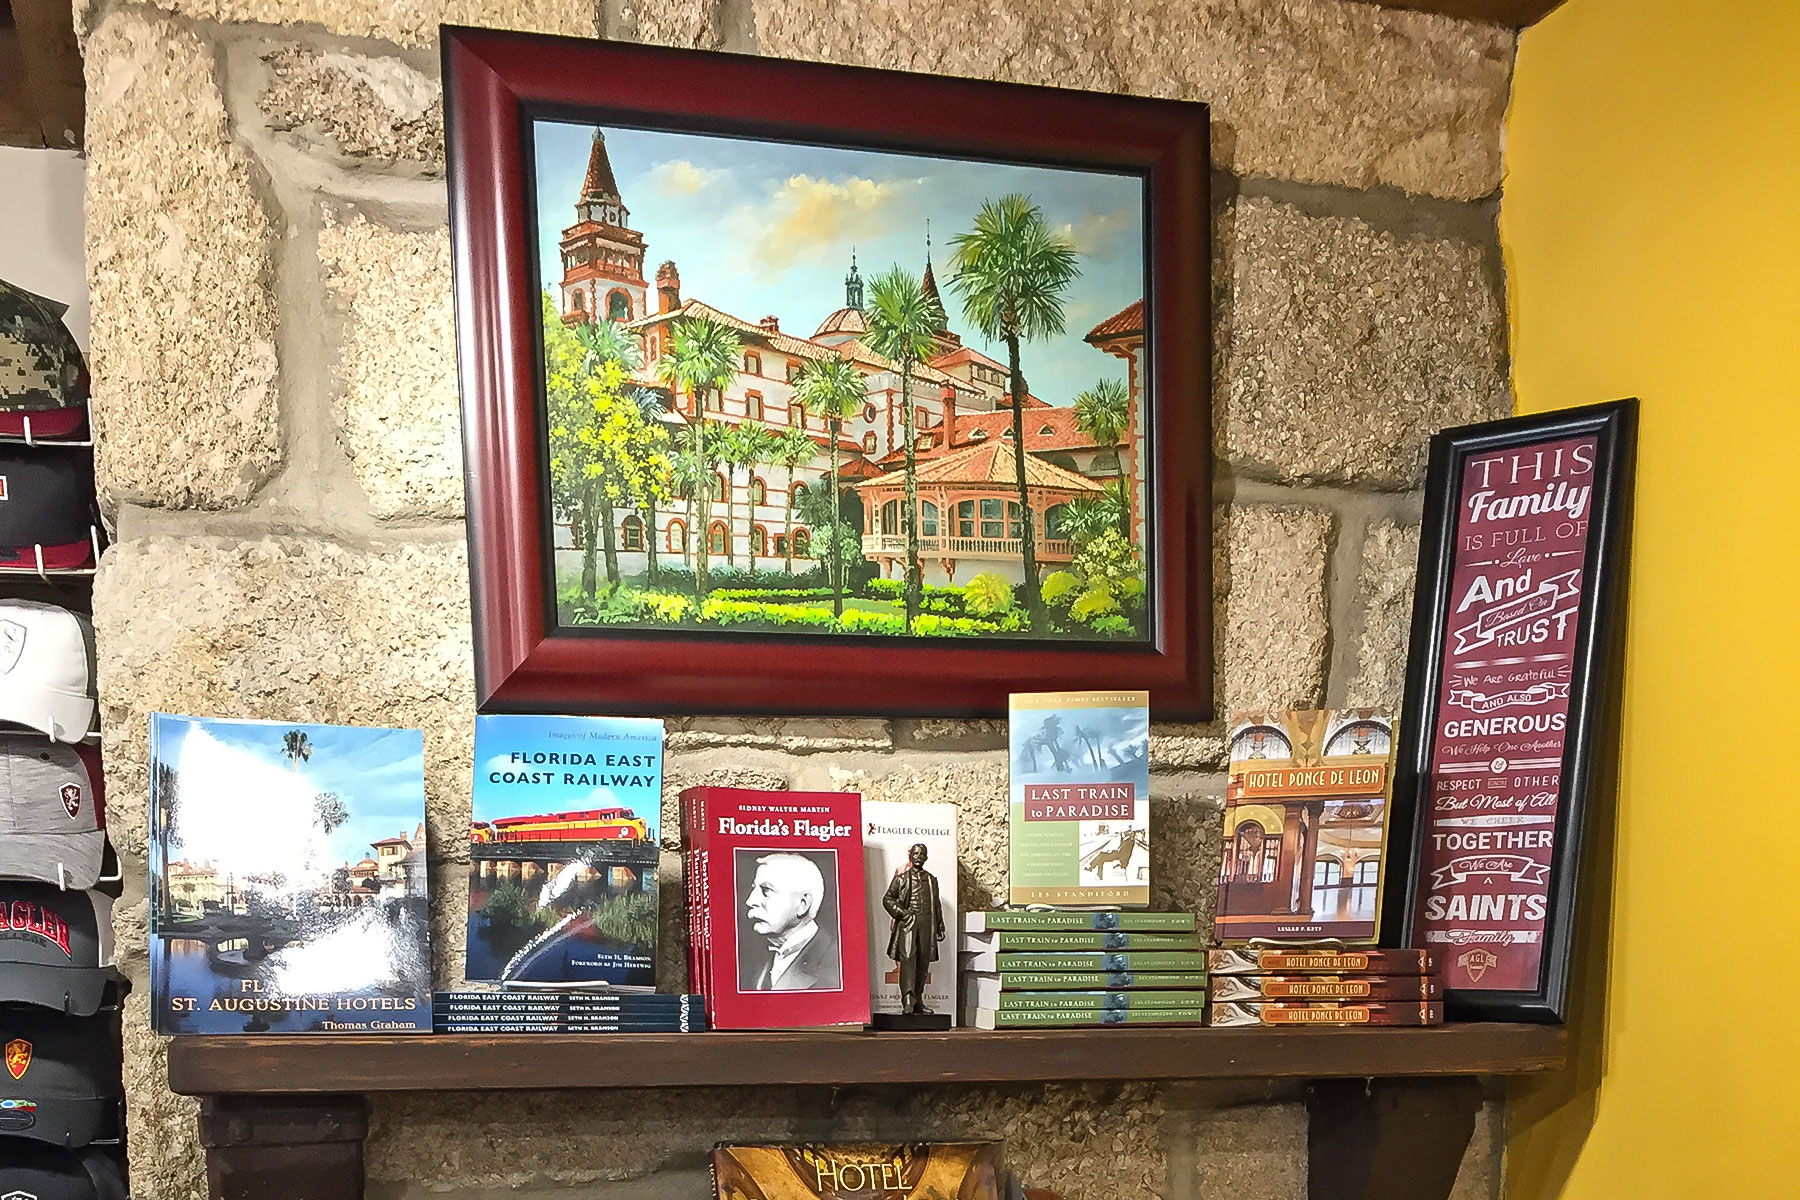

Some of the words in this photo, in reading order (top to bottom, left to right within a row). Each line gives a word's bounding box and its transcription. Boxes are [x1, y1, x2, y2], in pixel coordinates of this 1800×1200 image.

[1472, 444, 1593, 488] THIS
[1469, 482, 1590, 523] Family
[1465, 535, 1482, 550] IS
[1491, 526, 1546, 547] FULL
[1556, 521, 1587, 538] OF
[1500, 548, 1541, 568] Love
[1456, 569, 1531, 613] And
[1485, 603, 1527, 627] Based
[1497, 606, 1578, 647] TRUST
[1464, 676, 1478, 687] We
[1482, 698, 1503, 709] AND
[1507, 694, 1531, 702] ALSO
[1444, 713, 1566, 737] GENEROUS
[1442, 743, 1465, 755] We
[1465, 743, 1491, 755] Help
[1494, 742, 1518, 753] One
[1520, 740, 1561, 753] Another
[511, 752, 597, 766] FLORIDA
[606, 754, 655, 767] EAST
[489, 772, 555, 785] COAST
[564, 773, 655, 787] RAILWAY
[1249, 773, 1283, 788] HOTEL
[1289, 771, 1325, 786] PONCE
[1330, 771, 1344, 784] DE
[1349, 769, 1379, 784] LEON
[1437, 779, 1481, 791] RESPECT
[1514, 775, 1559, 787] OTHER
[1031, 788, 1070, 800] LAST
[1077, 788, 1129, 800] TRAIN
[1435, 796, 1467, 810] But
[1470, 794, 1513, 809] Most
[1515, 795, 1530, 812] of
[1529, 792, 1557, 806] All
[1031, 808, 1043, 817] to
[1046, 805, 1129, 817] PARADISE
[718, 817, 789, 836] Florida's
[794, 820, 852, 841] Flagler
[878, 826, 912, 834] FLAGLER
[915, 827, 949, 835] COLLEGE
[1432, 831, 1553, 850] TOGETHER
[1459, 859, 1486, 870] We
[1486, 859, 1513, 871] Are
[1425, 894, 1547, 920] SAINTS
[1445, 929, 1515, 946] Family
[1287, 958, 1306, 967] HOTEL
[1309, 958, 1331, 967] PONCE
[1333, 958, 1341, 967] DE
[1345, 958, 1361, 967] LEON
[1289, 985, 1309, 994] HOTEL
[1311, 985, 1333, 994] PONCE
[1336, 985, 1344, 994] DE
[1346, 985, 1363, 994] LEON
[171, 998, 201, 1011] ST.
[208, 998, 329, 1011] AUGUSTINE
[336, 998, 416, 1010] HOTELS
[322, 1020, 367, 1030] Thomas
[371, 1020, 416, 1030] Graham
[814, 1159, 913, 1192] HOTEL
